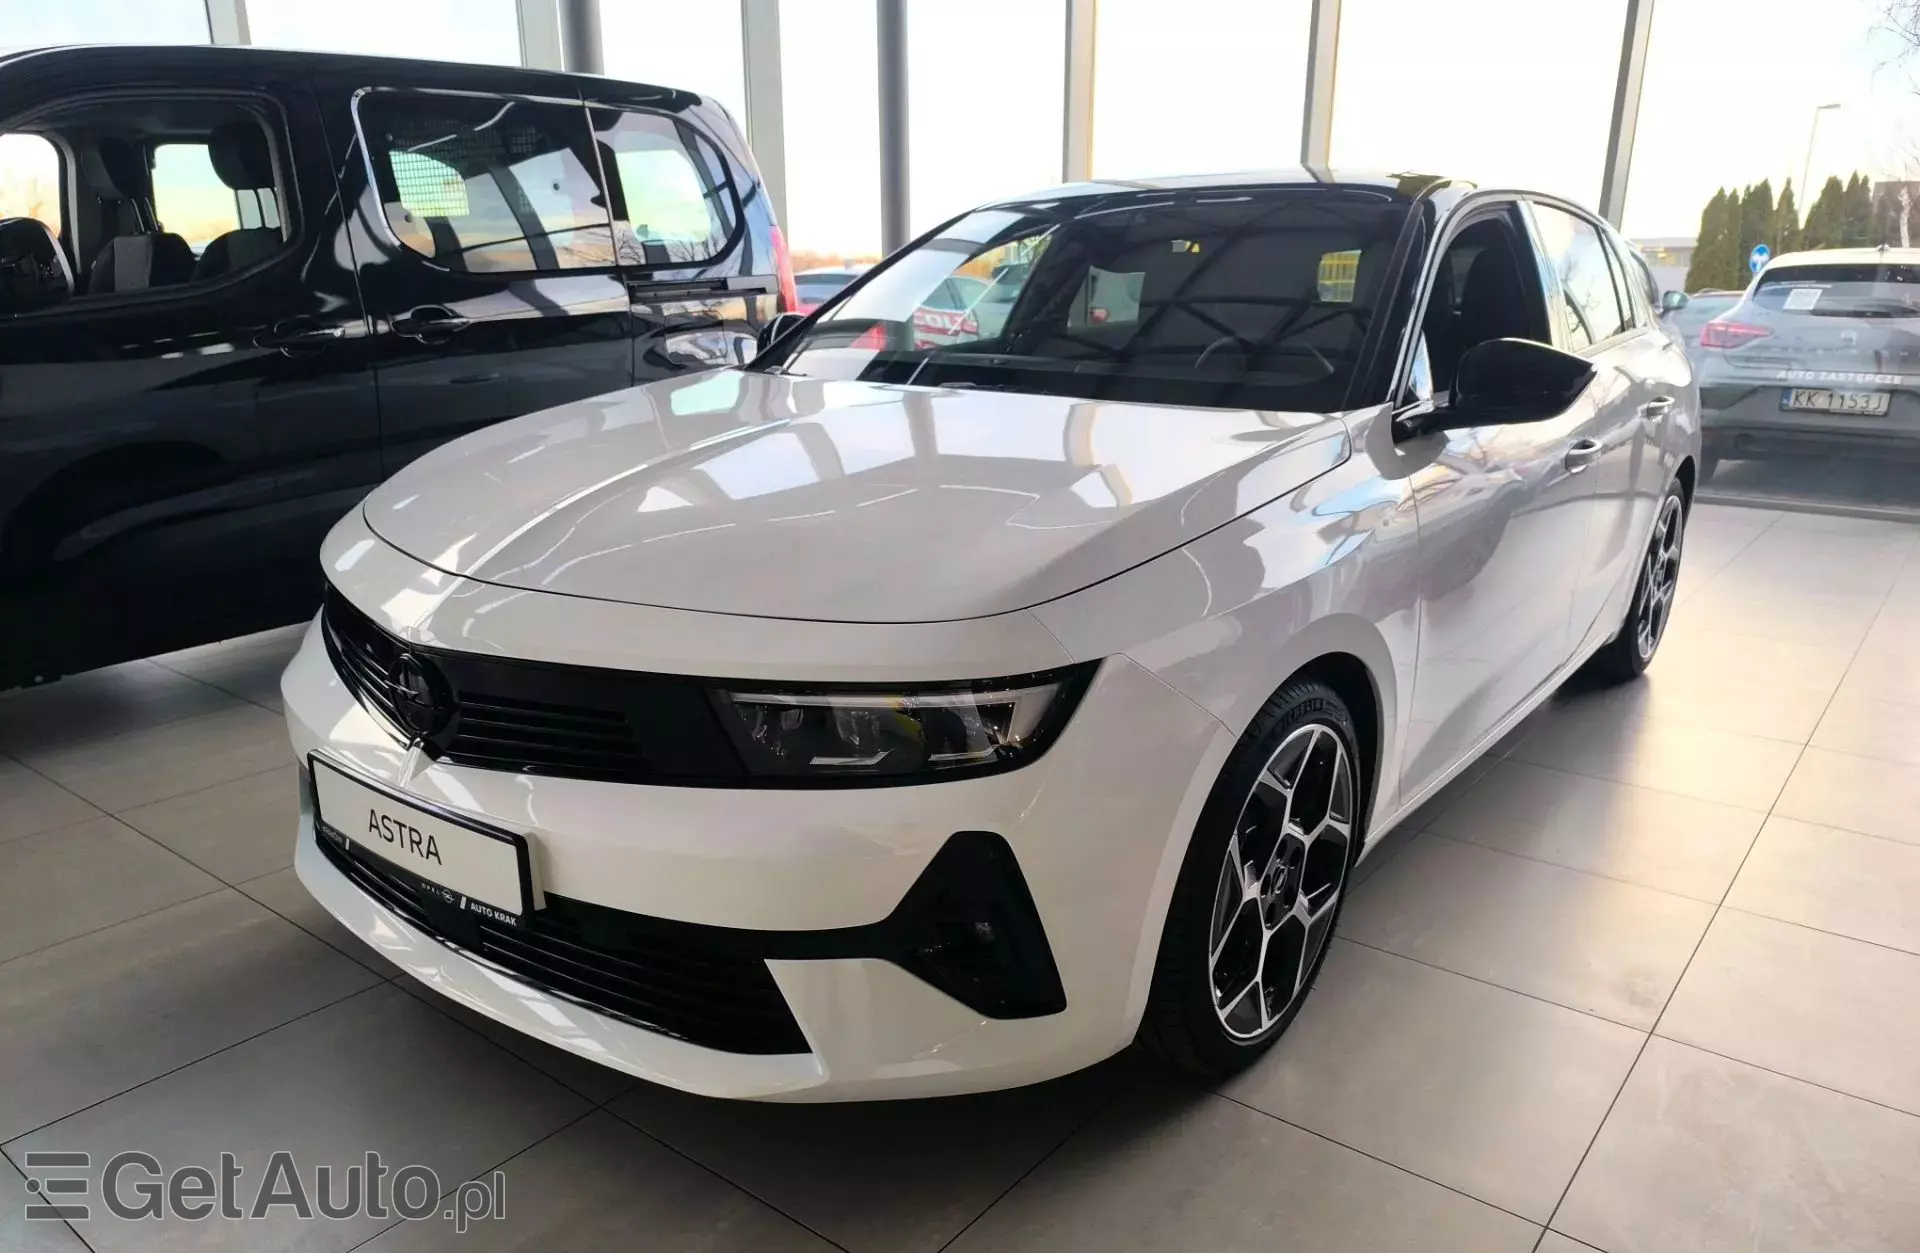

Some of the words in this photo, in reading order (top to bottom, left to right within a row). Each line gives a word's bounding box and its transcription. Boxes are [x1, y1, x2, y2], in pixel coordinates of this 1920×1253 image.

[1776, 370, 1813, 381] AUTO
[1793, 391, 1817, 407] KK
[1827, 392, 1884, 410] 1153J
[368, 808, 443, 865] ASTRA
[470, 902, 493, 918] AUTO
[494, 910, 517, 927] KRAK
